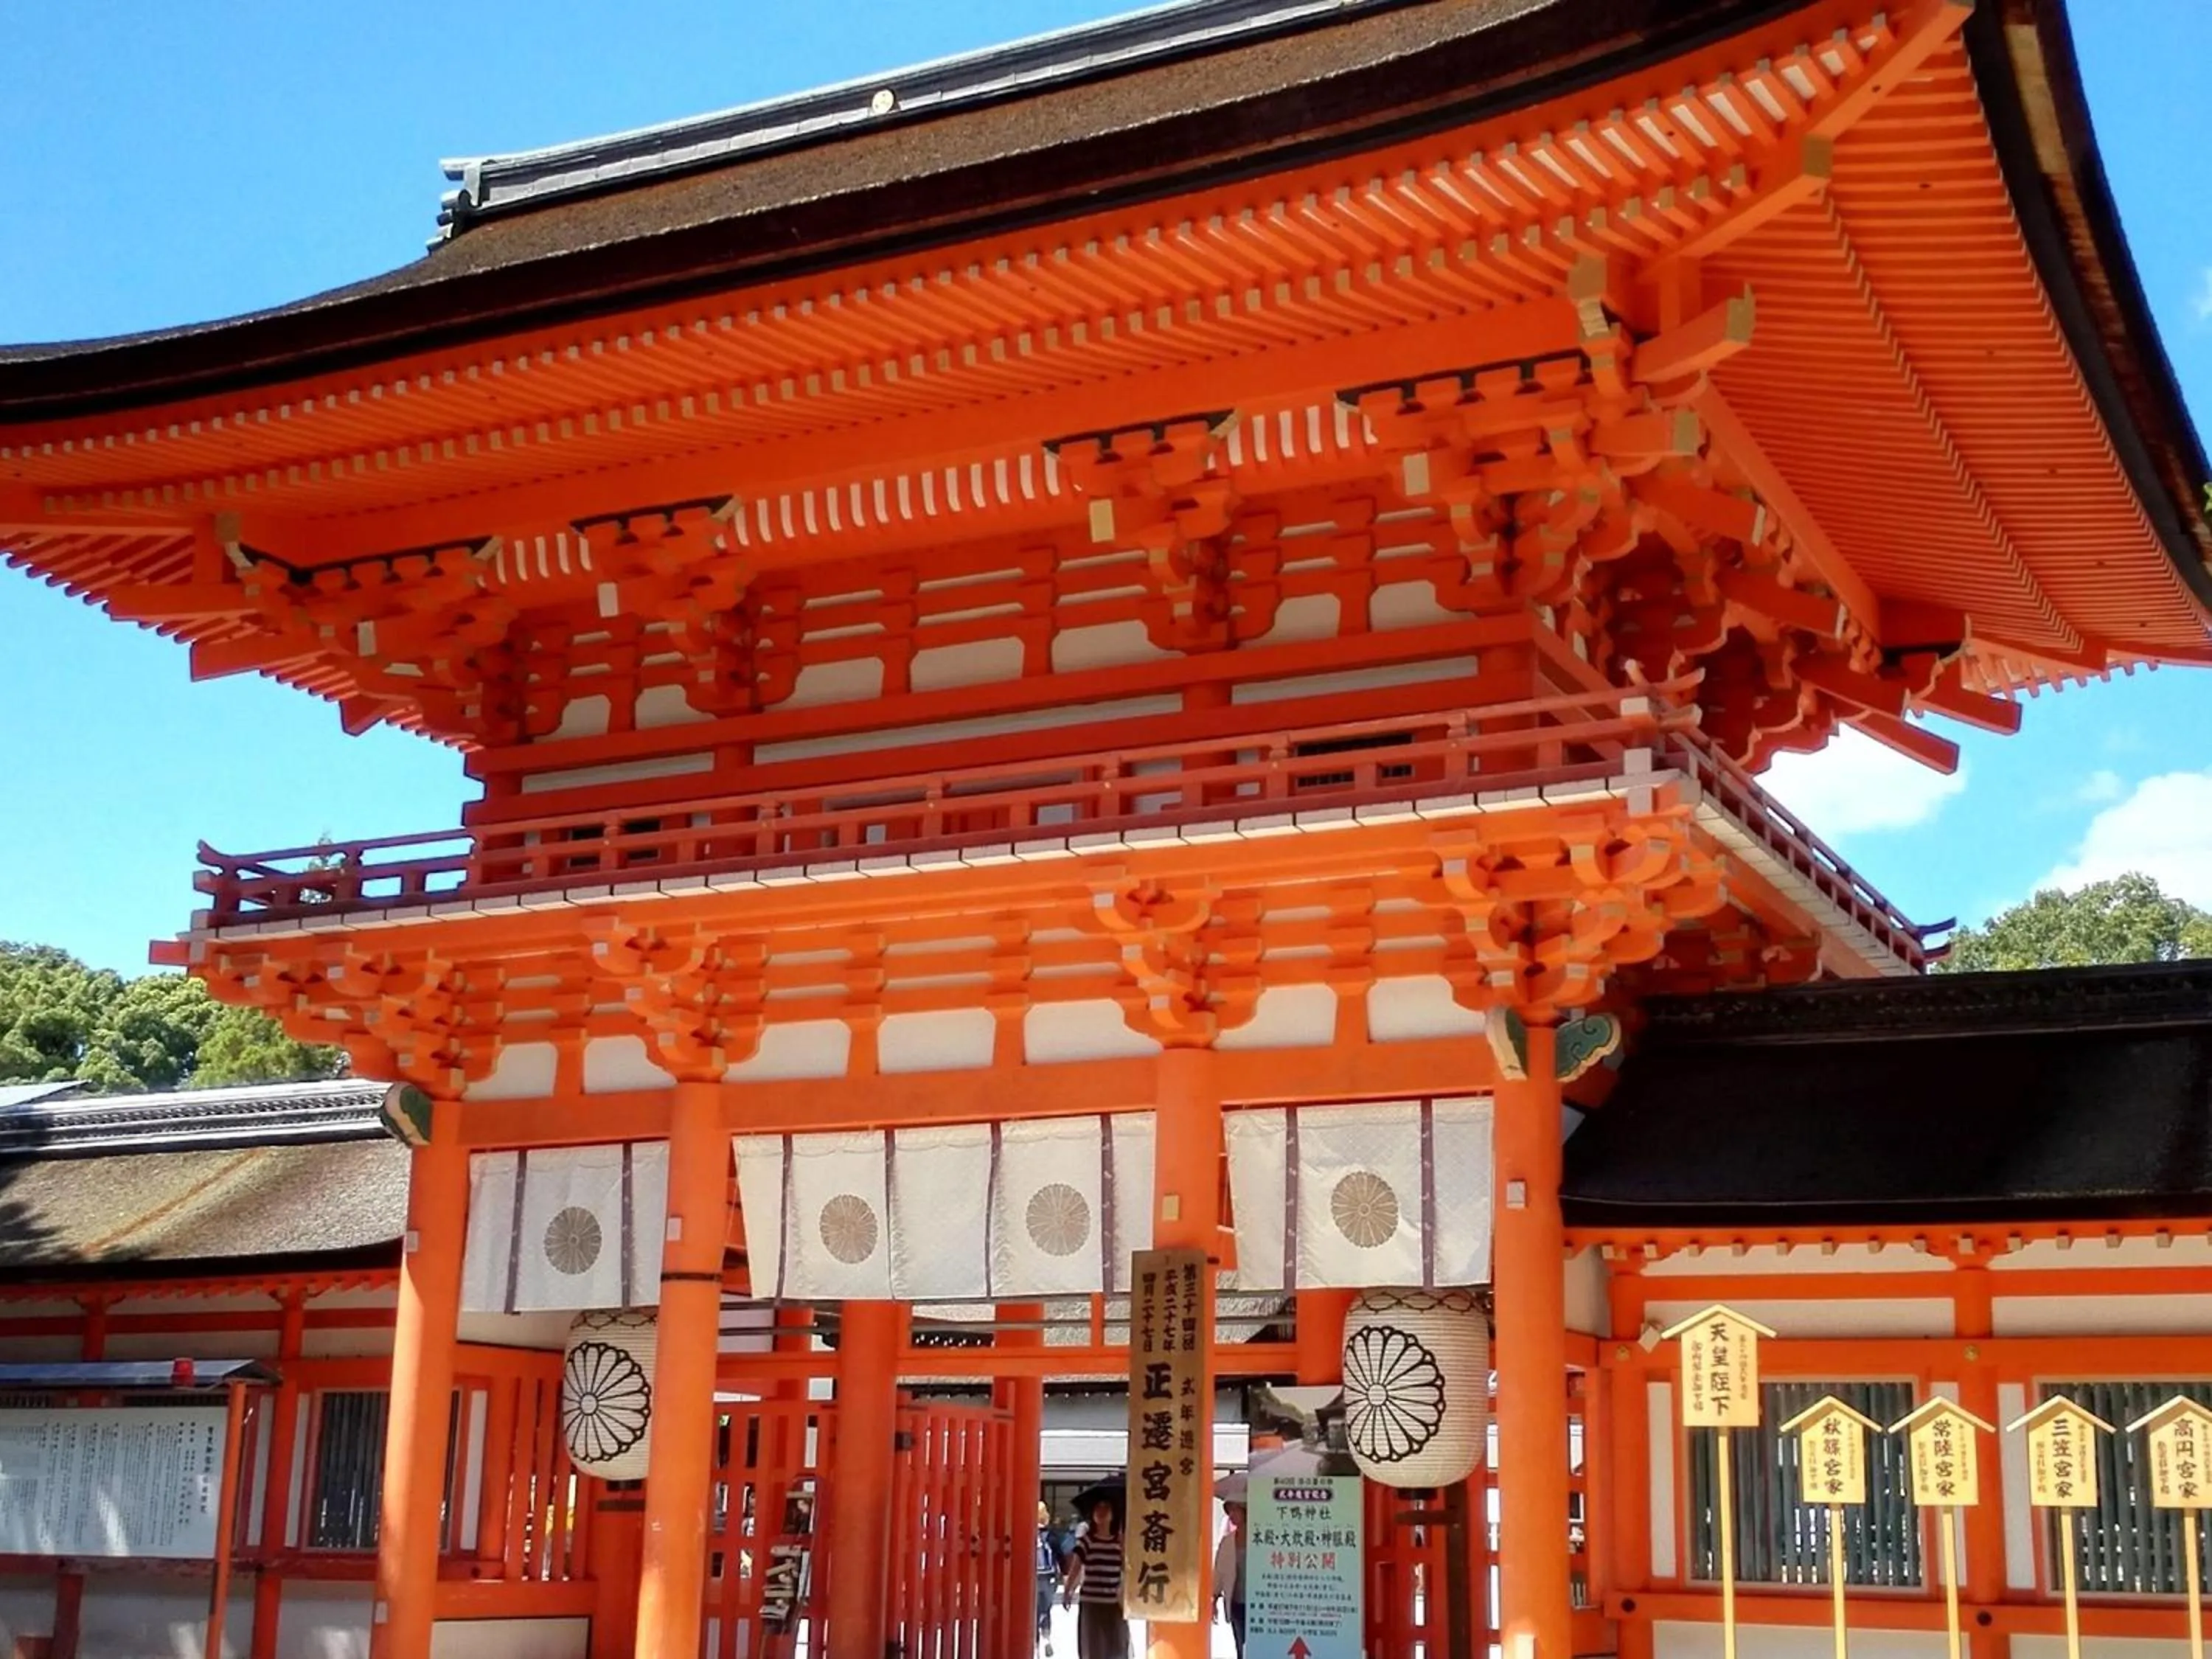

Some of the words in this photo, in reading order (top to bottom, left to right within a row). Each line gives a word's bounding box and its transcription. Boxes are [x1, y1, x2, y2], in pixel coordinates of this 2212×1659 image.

[1141, 1272, 1156, 1352] 四月二十七日
[1163, 1269, 1178, 1353] 平成二十七年
[1710, 1322, 1731, 1416] 天皇陛下
[1137, 1362, 1175, 1604] 正遷宮斎行
[1822, 1417, 1843, 1495] 秋篠宮家
[1933, 1419, 1955, 1497] 常陸宮家
[2051, 1418, 2073, 1498] 三笠宮家
[2174, 1418, 2198, 1498] 高円宮家
[1270, 1551, 1336, 1571] 特別公開
